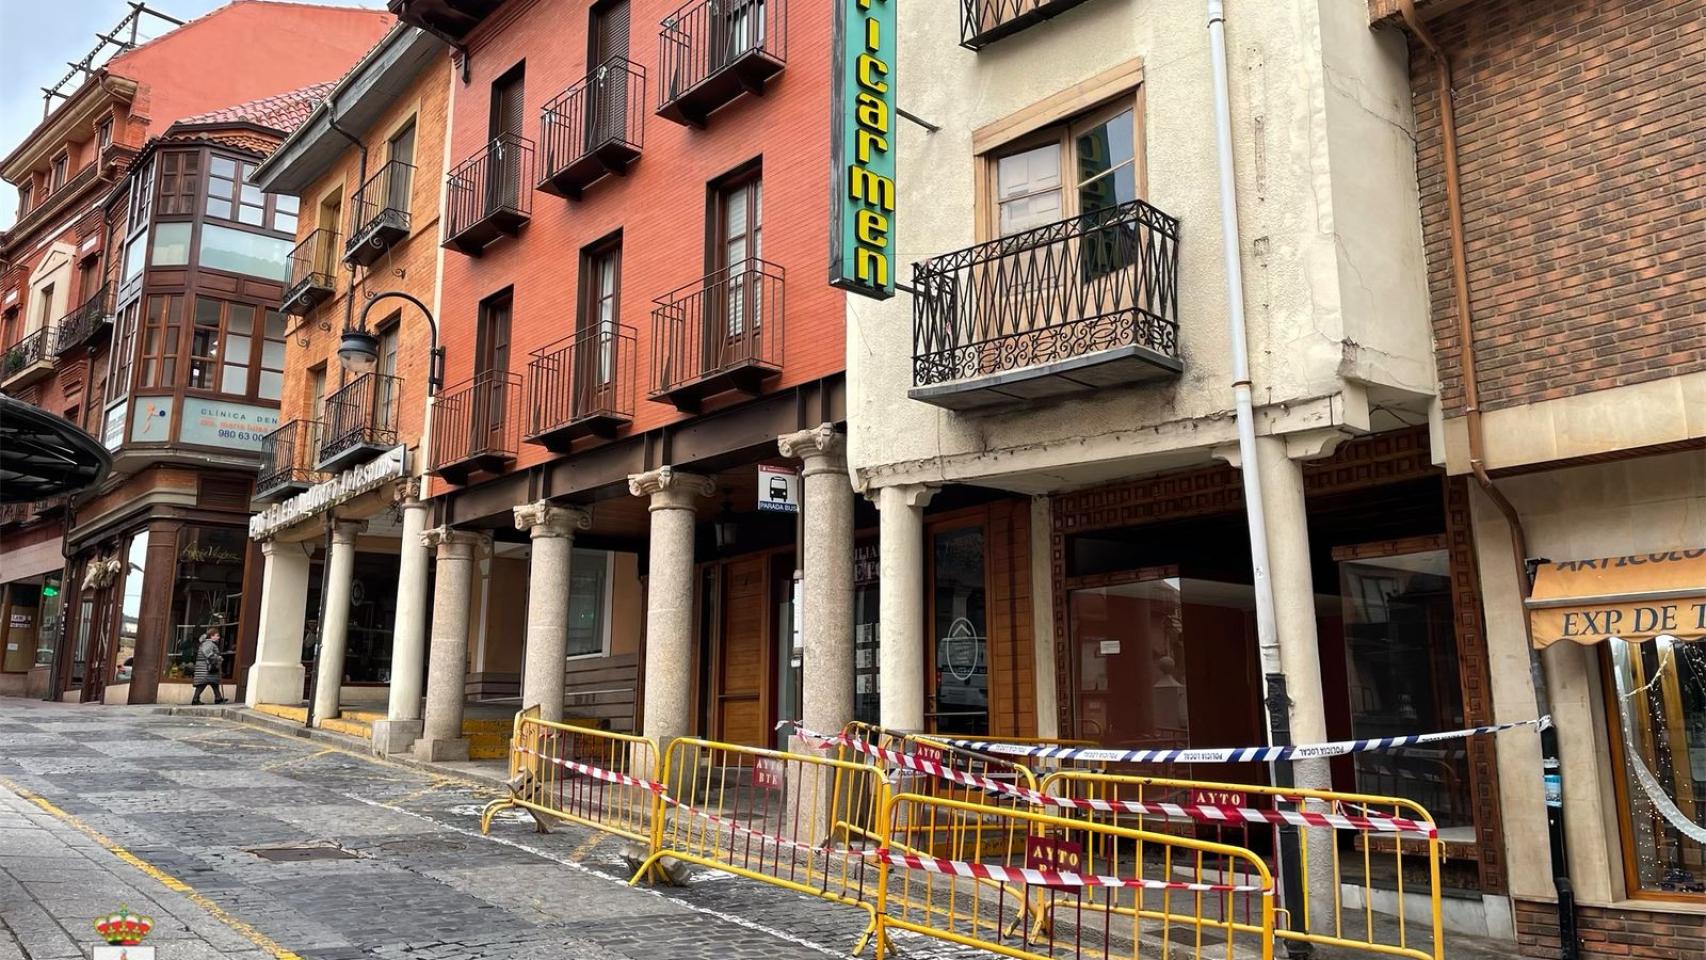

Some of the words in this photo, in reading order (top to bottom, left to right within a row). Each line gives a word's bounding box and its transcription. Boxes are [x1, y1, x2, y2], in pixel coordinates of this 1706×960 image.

[847, 0, 895, 288] icarmen
[218, 429, 236, 438] 980
[238, 431, 250, 440] 63
[760, 502, 784, 511] PARADA
[784, 504, 798, 512] BUS
[1562, 609, 1623, 637] EXP.
[1632, 605, 1678, 633] DE
[917, 747, 941, 761] AYTO
[1299, 748, 1320, 757] LOCAL
[1196, 791, 1241, 806] AYTO
[1033, 845, 1079, 866] AYTO
